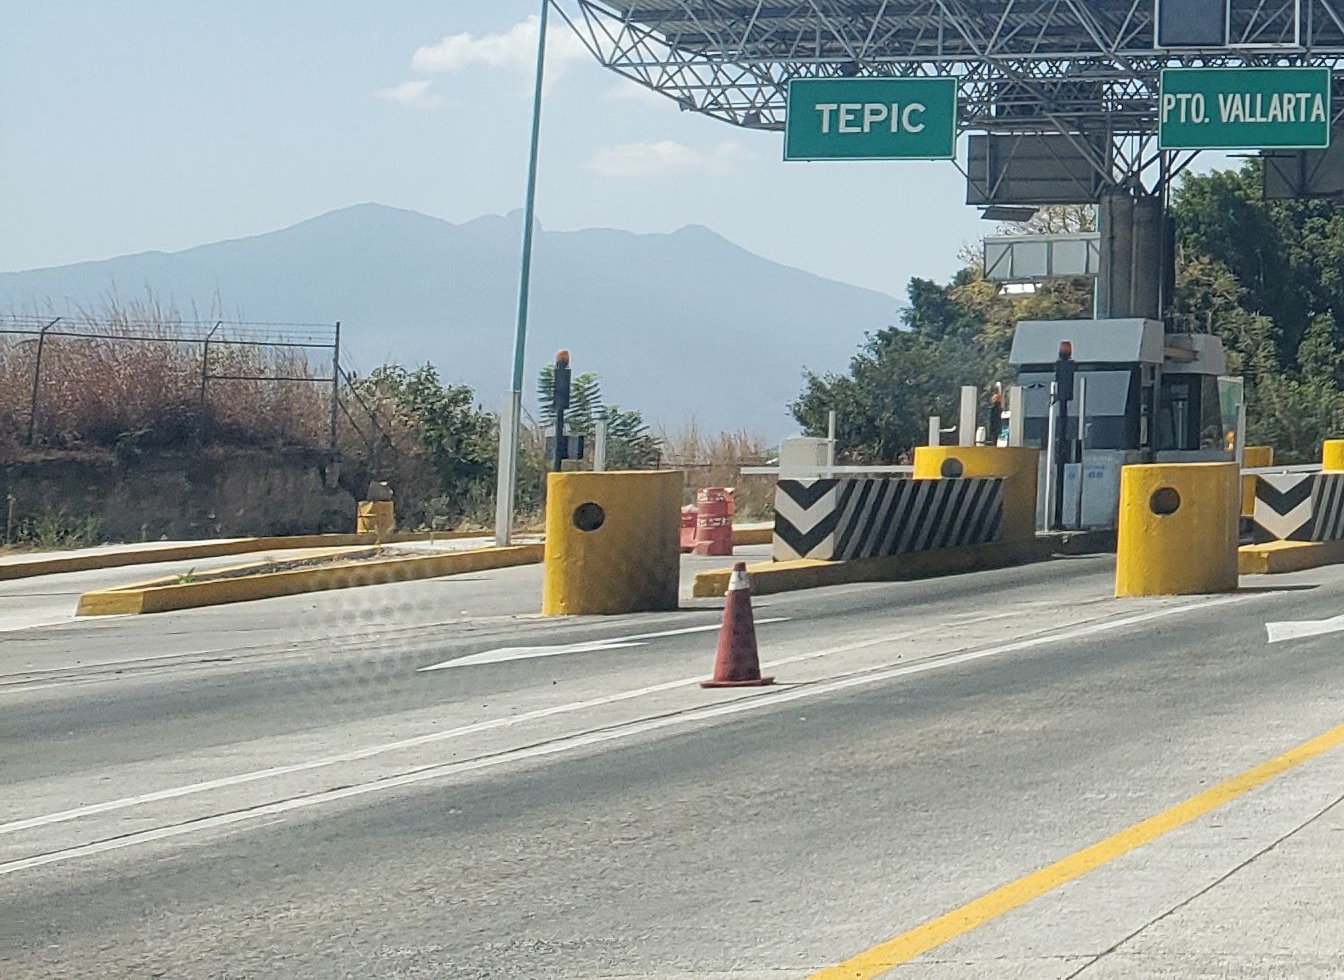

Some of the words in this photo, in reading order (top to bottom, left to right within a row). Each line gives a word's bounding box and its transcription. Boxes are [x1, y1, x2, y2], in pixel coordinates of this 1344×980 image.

[814, 102, 927, 134] TEPIC
[1162, 92, 1210, 124] PTO.
[1217, 92, 1327, 123] VALLARTA
